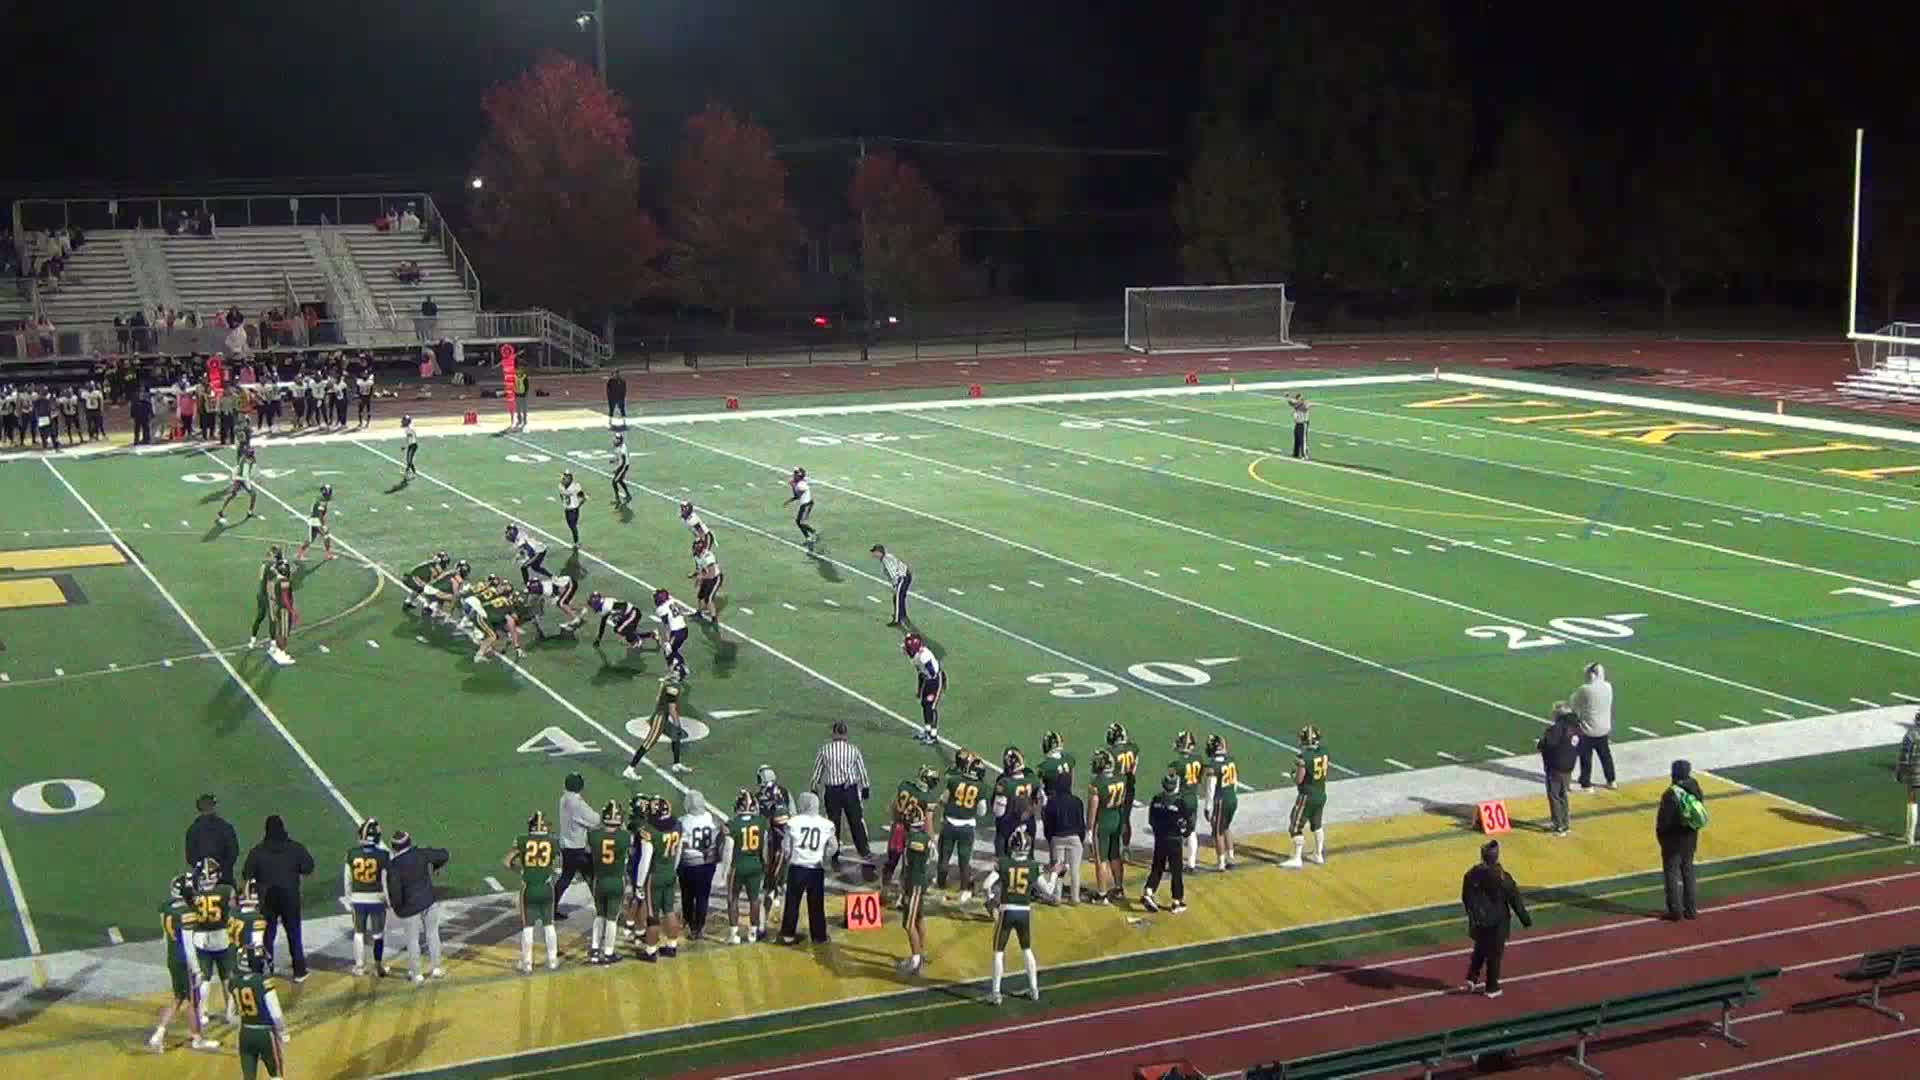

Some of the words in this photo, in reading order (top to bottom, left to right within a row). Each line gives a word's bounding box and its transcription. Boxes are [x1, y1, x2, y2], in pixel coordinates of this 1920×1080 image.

[1483, 804, 1507, 830] 30
[741, 825, 760, 851] 16
[800, 827, 821, 851] 70
[525, 840, 551, 867] 23
[602, 839, 615, 865] 5
[352, 858, 377, 883] 22
[1007, 867, 1029, 894] 15
[850, 896, 878, 926] 40
